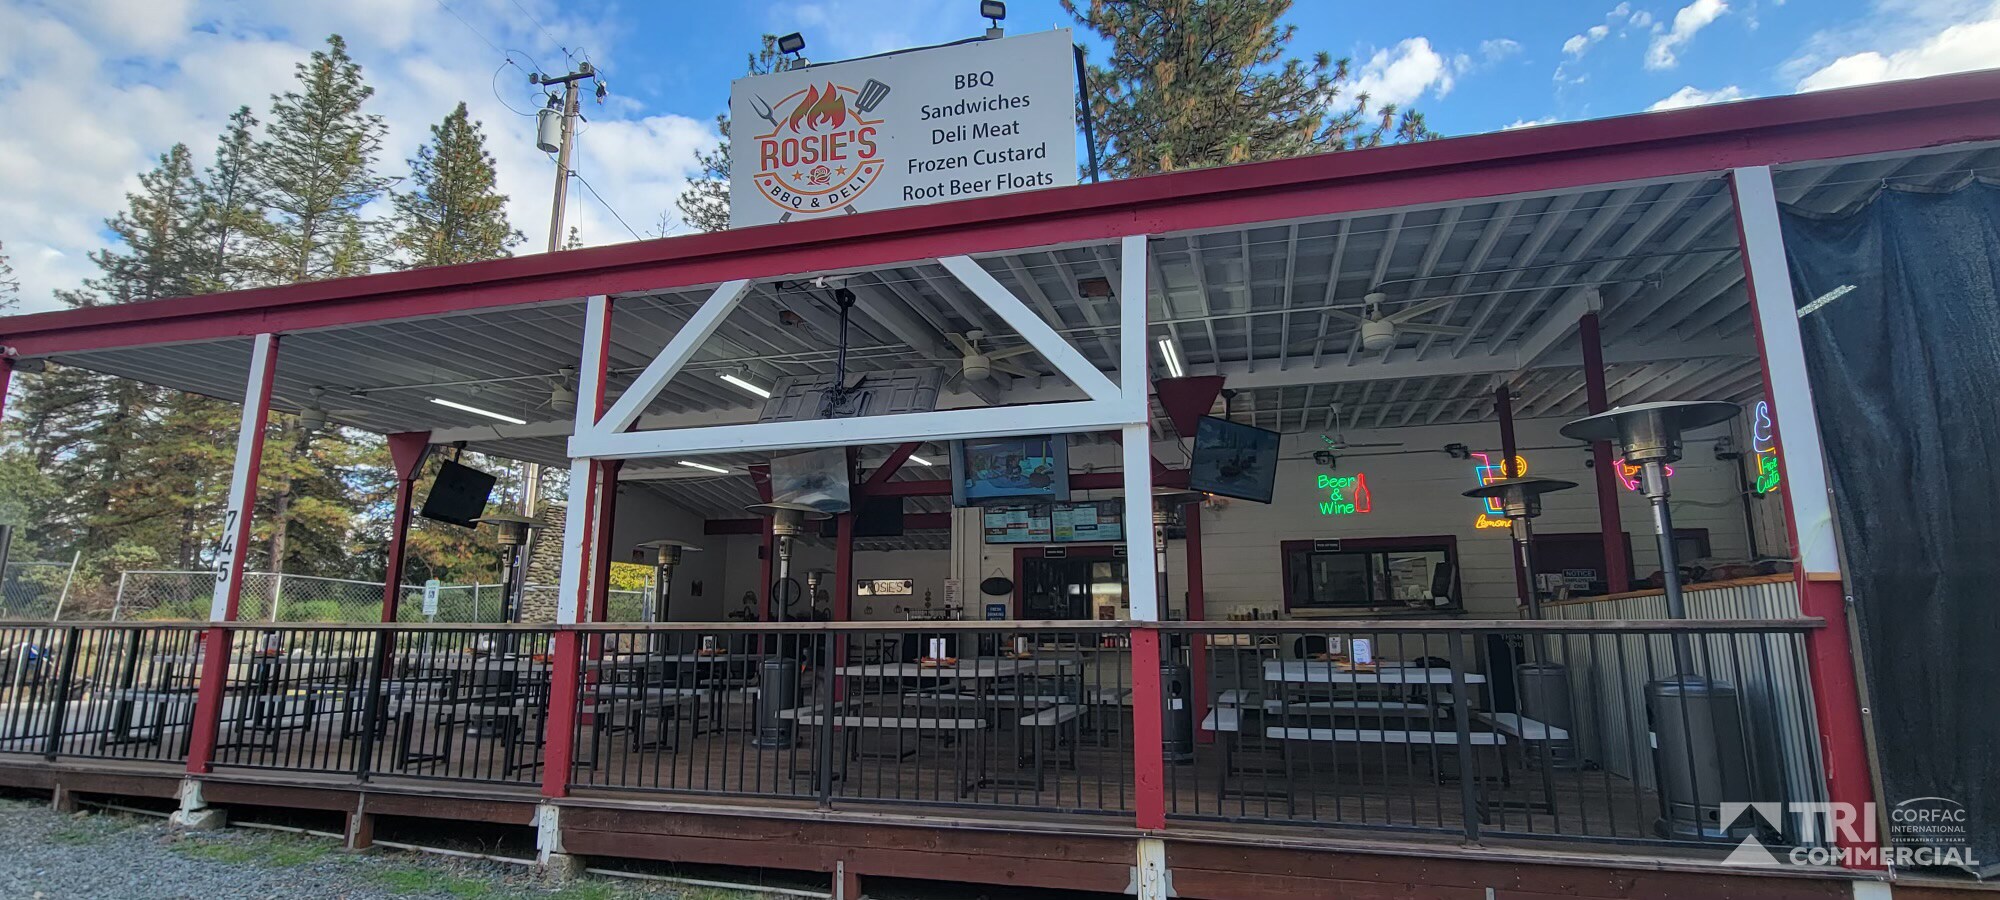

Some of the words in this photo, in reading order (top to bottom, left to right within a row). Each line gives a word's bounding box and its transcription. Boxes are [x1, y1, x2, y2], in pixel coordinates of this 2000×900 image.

[954, 70, 994, 90] BBQ
[921, 94, 1030, 121] Sandwiches
[932, 125, 967, 145] Deli
[972, 121, 1020, 140] Meat
[760, 126, 877, 171] ROSIE'S
[908, 154, 968, 174] Frozen
[973, 142, 1046, 165] Custard
[771, 186, 802, 208] BBQ
[810, 197, 820, 208] &
[829, 176, 866, 204] DELI
[903, 182, 945, 201] Root
[950, 178, 992, 196] Beer
[997, 171, 1053, 190] Floats
[1317, 474, 1355, 489] Beer
[1330, 487, 1344, 501] &
[1319, 502, 1355, 515] Wine
[217, 510, 238, 583] 745
